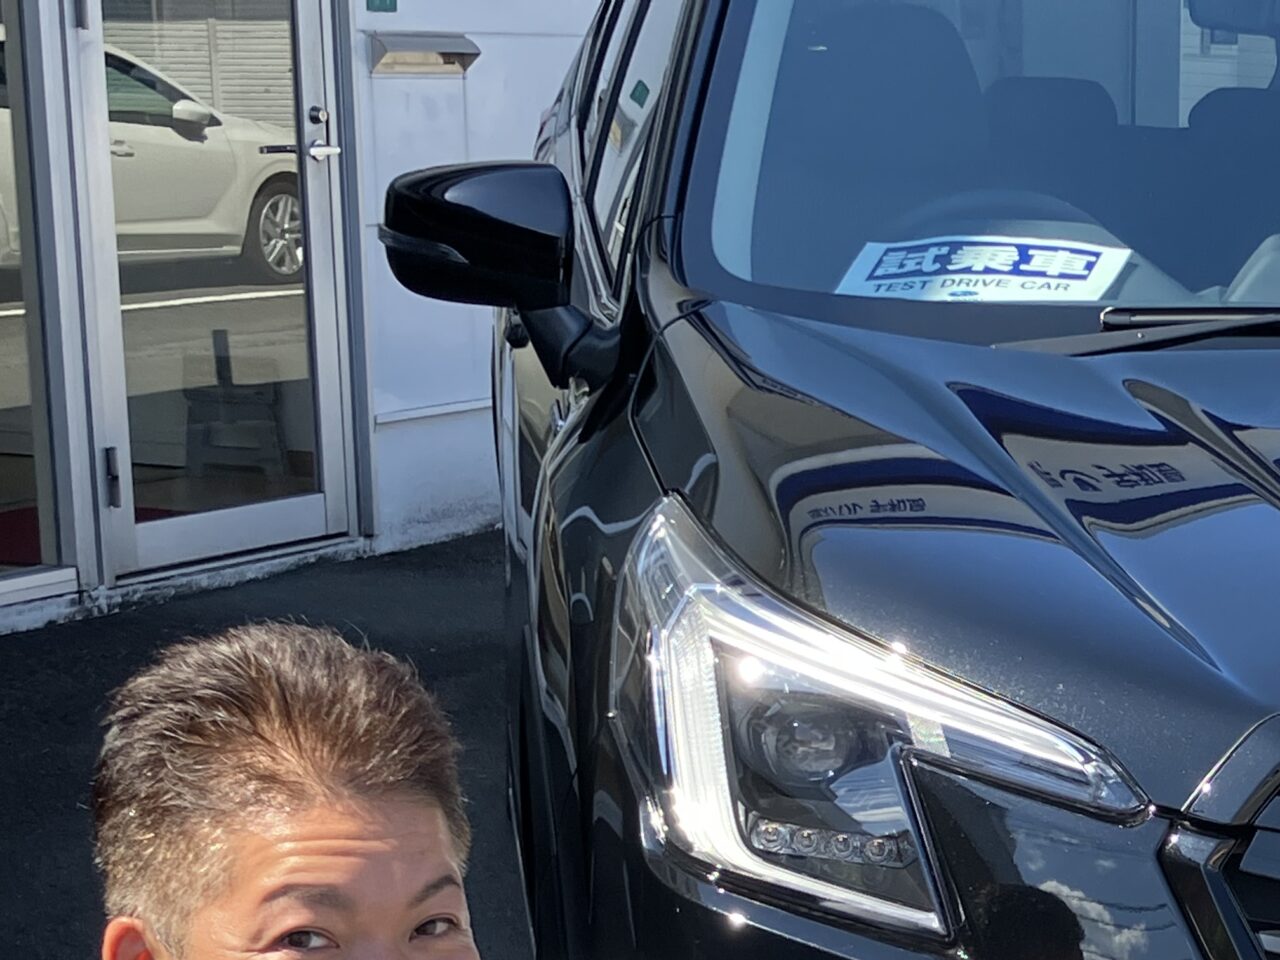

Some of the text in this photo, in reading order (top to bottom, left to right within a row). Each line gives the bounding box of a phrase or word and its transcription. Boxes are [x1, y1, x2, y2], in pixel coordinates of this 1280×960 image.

[873, 246, 1096, 276] 試乗車
[873, 278, 1071, 293] TEST DRIVE CAR
